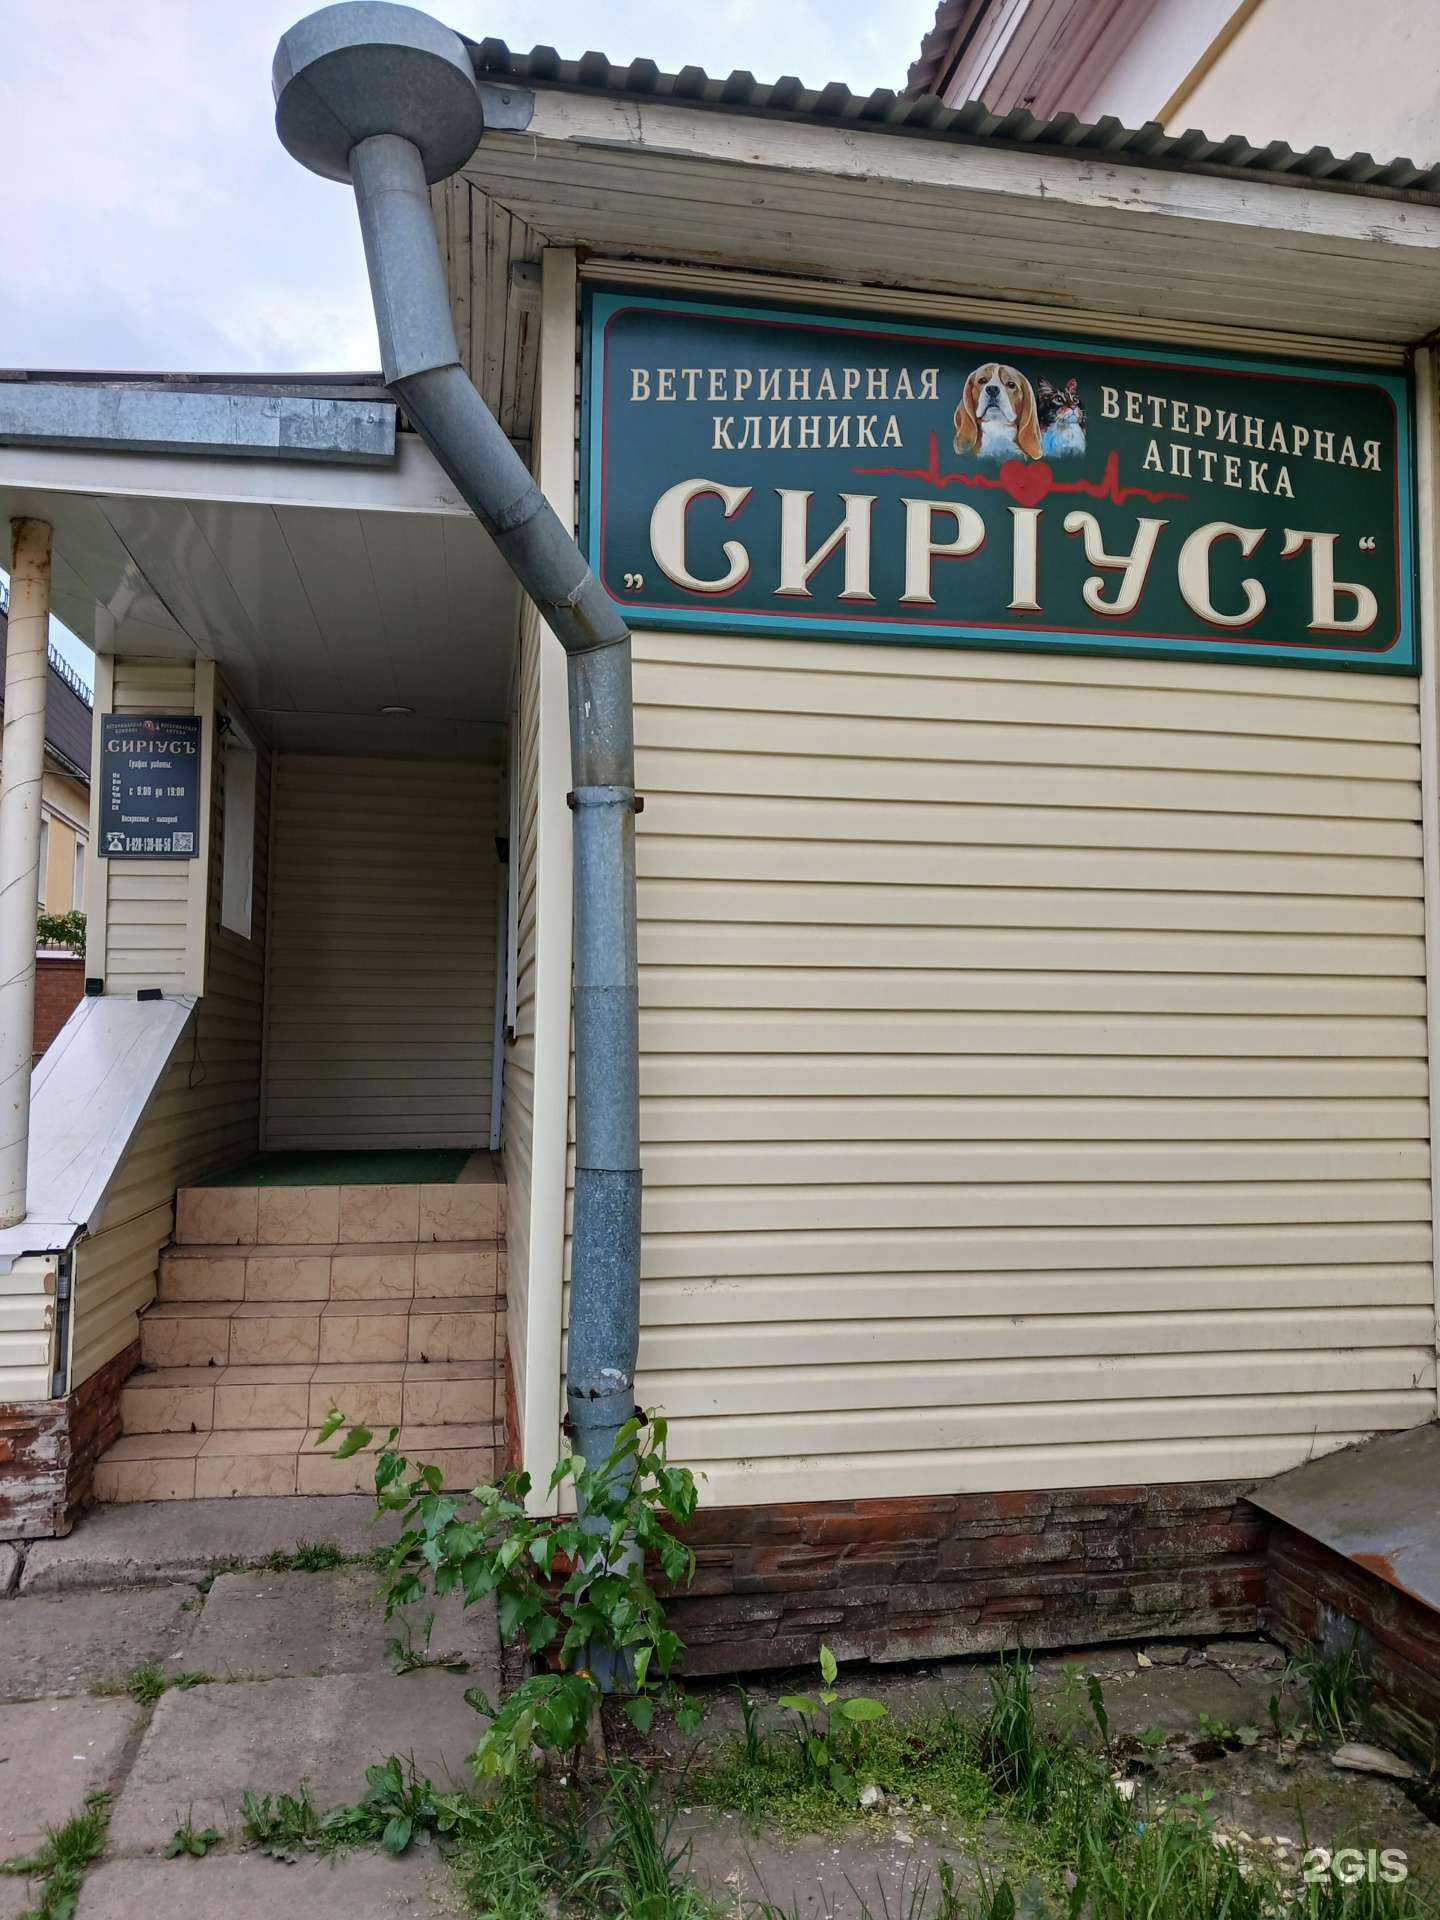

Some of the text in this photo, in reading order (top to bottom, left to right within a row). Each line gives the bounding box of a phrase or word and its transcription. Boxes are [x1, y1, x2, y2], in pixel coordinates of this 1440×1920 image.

[629, 366, 941, 402] ВЕТЕРИНАРНАЯ
[712, 413, 904, 450] КЛИНИКА
[1099, 385, 1382, 473] ВЕТЕРИНАРНАЯ
[1143, 438, 1296, 499] АПТЕКА
